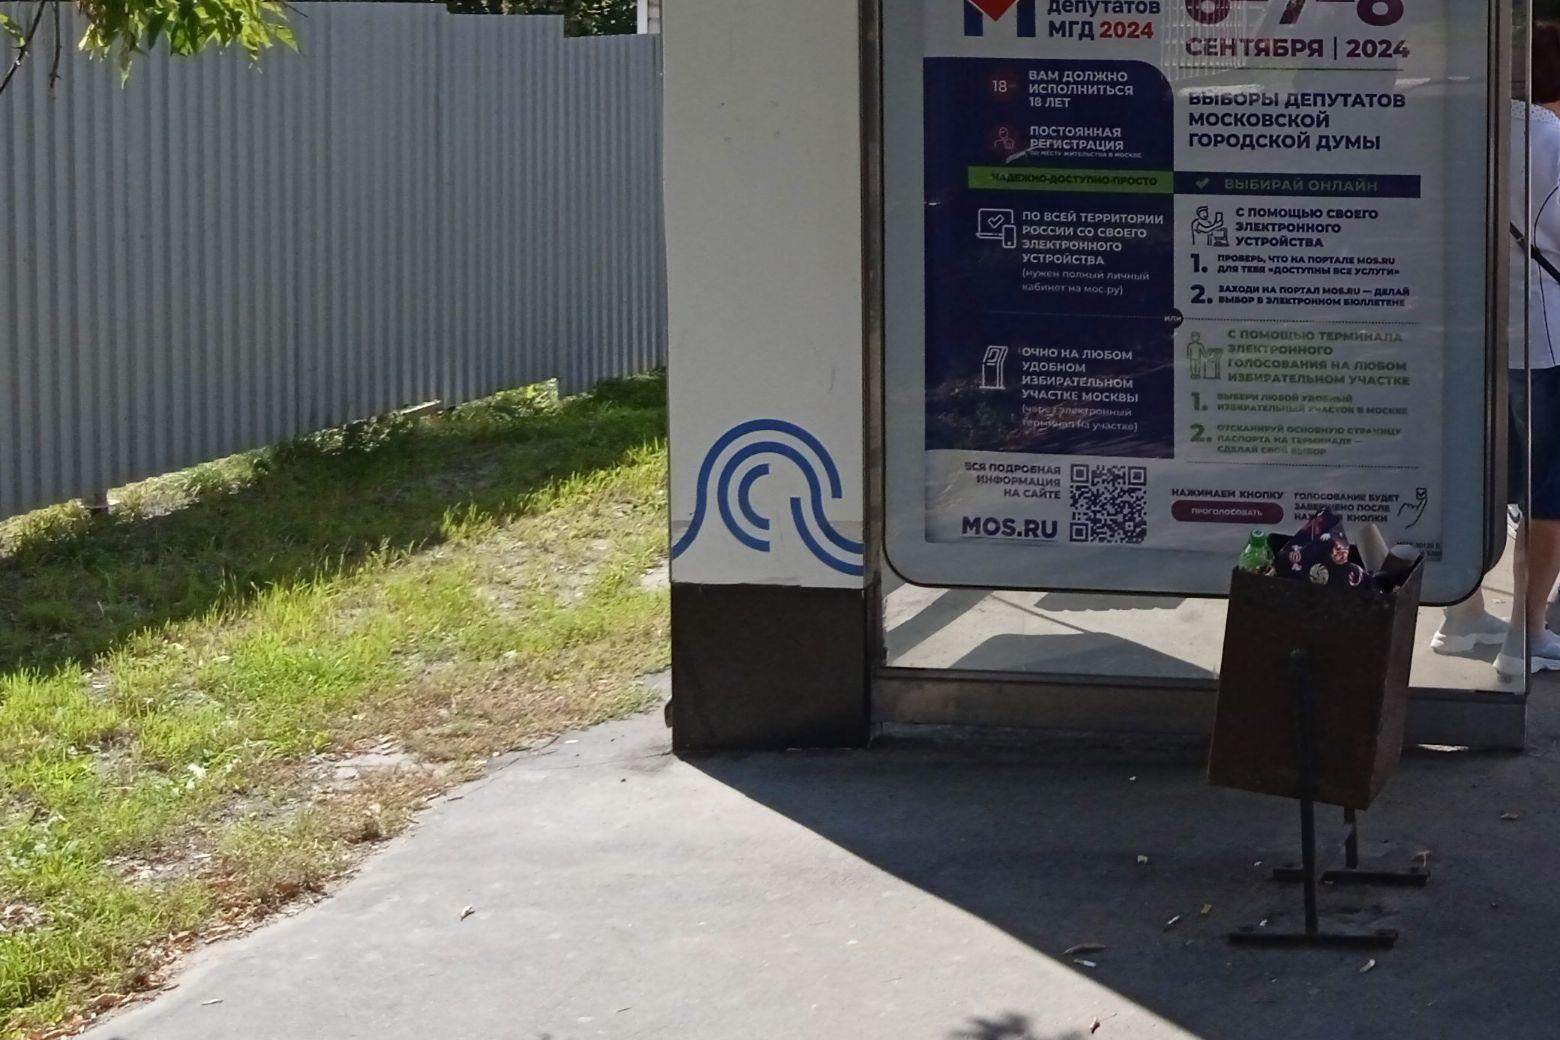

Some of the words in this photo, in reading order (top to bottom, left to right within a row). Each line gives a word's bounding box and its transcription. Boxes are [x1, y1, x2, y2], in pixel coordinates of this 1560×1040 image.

[1048, 21, 1095, 41] МГД
[1100, 21, 1154, 40] 2024
[1185, 38, 1324, 58] СЕНТЯБРЯ
[1346, 38, 1410, 59] 2024
[1028, 70, 1059, 81] ВАМ
[1063, 70, 1128, 83] ДОЛЖНО
[1028, 84, 1134, 96] ИСПОЛНИТЬСЯ
[1028, 97, 1042, 107] 18
[1045, 97, 1072, 108] ЛЕТ
[1189, 92, 1280, 107] ВЫБОРЫ
[1285, 93, 1407, 110] ДЕПУТАТОВ
[1189, 110, 1331, 129] МОСКОВСКОЙ
[1030, 126, 1122, 138] ПОСТОЯННАЯ
[1030, 139, 1124, 152] РЕГИСТРАЦИЯ
[1189, 131, 1311, 150] ГОРОДСКОЙ
[1316, 134, 1381, 152] ДУМЫ
[1224, 177, 1302, 192] ВЫБИРАЙ
[1307, 177, 1378, 192] ОНЛАЙН
[1022, 211, 1041, 221] ПО
[1043, 210, 1077, 222] ВСЕЙ
[1080, 212, 1164, 224] ТЕРРИТОРИИ
[1235, 208, 1245, 217] С
[1247, 207, 1324, 220] ПОМОЩЬЮ
[1326, 209, 1378, 220] СВОЕГО
[1022, 226, 1074, 236] РОССИИ
[1077, 227, 1095, 237] СО
[1097, 228, 1147, 238] СВОЕГО
[1235, 222, 1342, 233] ЭЛЕКТРОННОГО
[1022, 240, 1123, 252] ЭЛЕКТРОННОГО
[1235, 235, 1324, 248] УСТРОЙСТВА
[1022, 253, 1105, 266] УСТРОЙСТВА
[1190, 254, 1208, 273] 1.
[1190, 284, 1213, 304] 2.
[1227, 329, 1237, 339] С
[1240, 330, 1315, 342] ПОМОЩЬЮ
[1318, 331, 1403, 343] ТЕРМИНАЛА
[1022, 347, 1058, 358] ОЧНО
[1061, 349, 1078, 359] НА
[1082, 349, 1132, 360] ЛЮБОМ
[1227, 344, 1333, 355] ЭЛЕКТРОННОГО
[1022, 362, 1086, 373] УДОБНОМ
[1227, 358, 1327, 370] ГОЛОСОВАНИЯ
[1331, 360, 1349, 370] НА
[1351, 360, 1407, 372] ЛЮБОМ
[1022, 375, 1133, 389] ИЗБИРАТЕЛЬНОМ
[1227, 372, 1345, 385] ИЗБИРАТЕЛЬНОМ
[1348, 374, 1411, 386] УЧАСТКЕ
[1022, 389, 1079, 400] УЧАСТКЕ
[1082, 391, 1139, 403] МОСКВЫ
[964, 462, 986, 472] ВСЯ
[989, 463, 1061, 475] ПОДРОБНАЯ
[976, 475, 1061, 488] ИНФОРМАЦИЯ
[1003, 488, 1020, 497] НА
[1022, 488, 1061, 499] САЙТЕ
[961, 515, 1058, 539] MOS.RU
